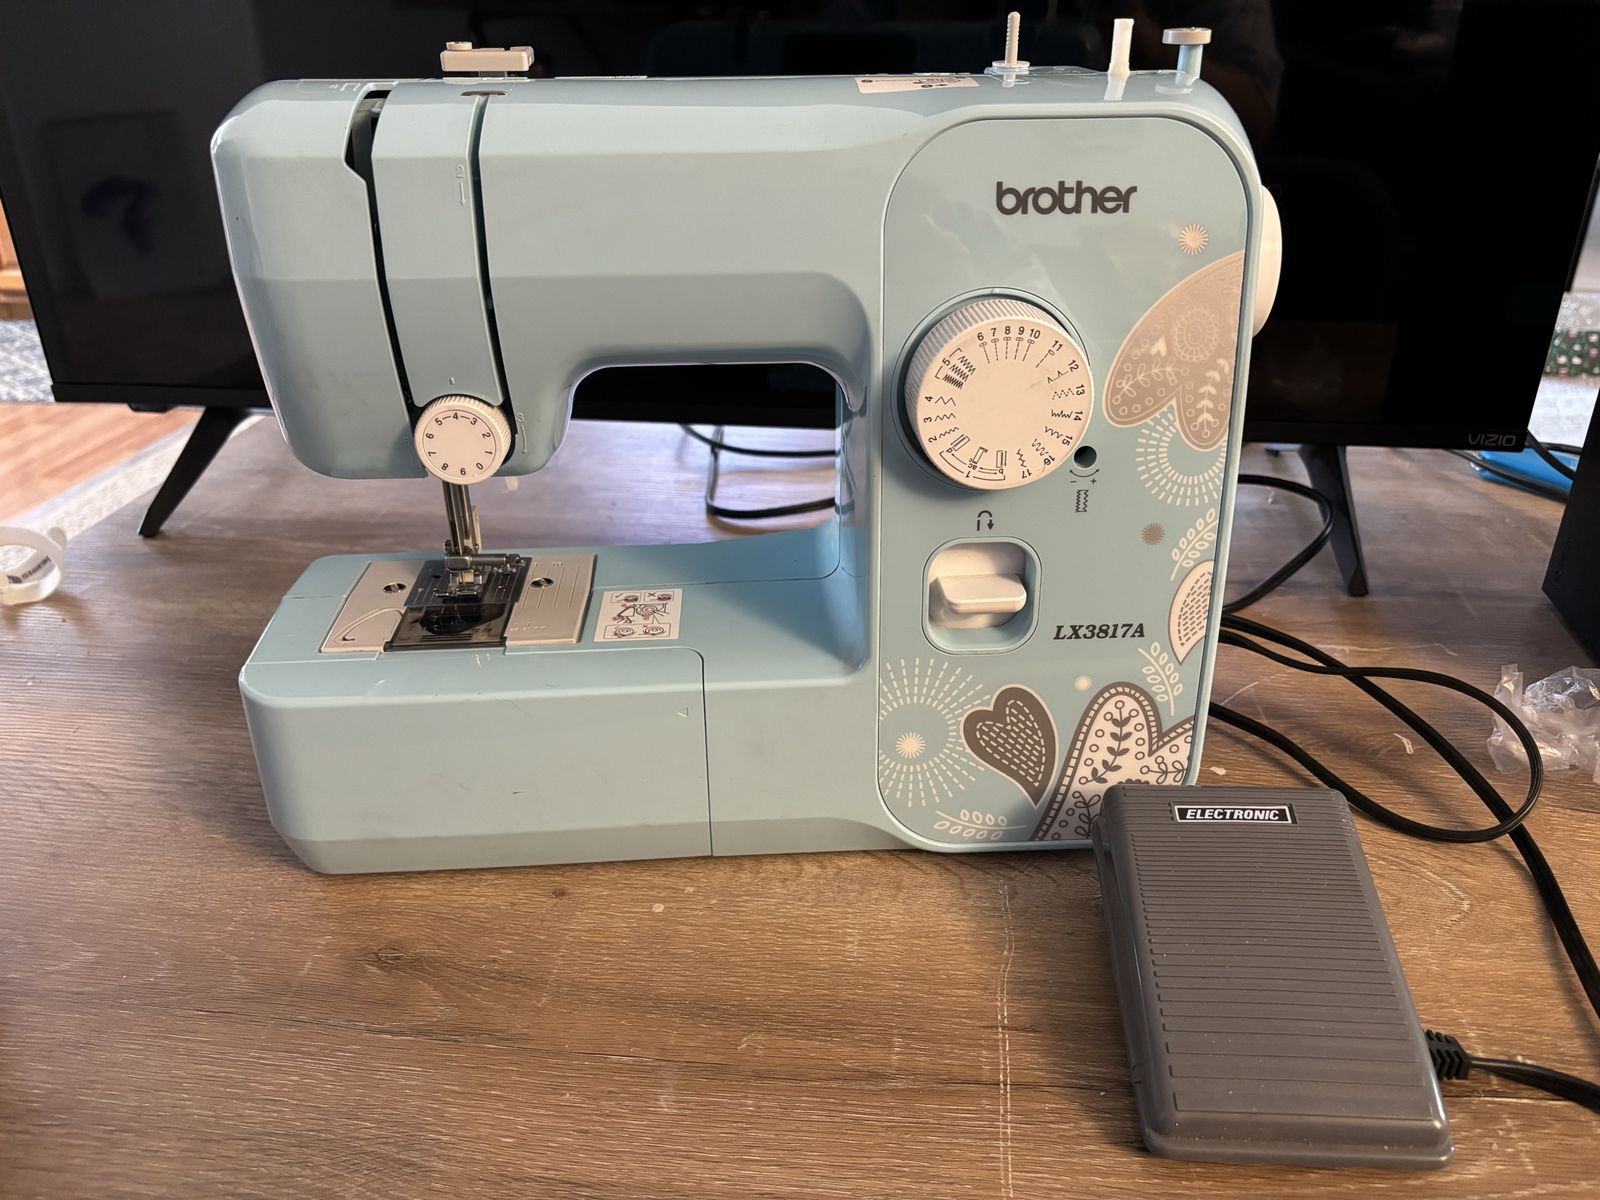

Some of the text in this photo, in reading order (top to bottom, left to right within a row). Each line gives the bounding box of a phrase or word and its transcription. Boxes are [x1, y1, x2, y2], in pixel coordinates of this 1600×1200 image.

[996, 180, 1138, 216] brother
[990, 328, 997, 336] 7
[1004, 326, 1011, 335] 8
[1018, 326, 1025, 335] 9
[1029, 328, 1041, 339] 10
[977, 332, 985, 341] 6
[1051, 340, 1063, 352] 11
[941, 357, 951, 367] 5
[1067, 359, 1079, 373] 12
[1075, 384, 1086, 396] 13
[924, 395, 934, 403] 4
[452, 412, 459, 420] 4
[923, 416, 933, 424] 3
[1073, 410, 1084, 422] 14
[434, 417, 443, 426] 5
[470, 417, 478, 426] 3
[425, 432, 435, 440] 6
[482, 432, 491, 440] 2
[927, 435, 938, 443] 2
[1061, 435, 1073, 446] 15
[1468, 433, 1517, 447] VIZIO
[1043, 455, 1055, 466] 16
[441, 462, 449, 471] 8
[476, 462, 484, 470] 0
[965, 470, 971, 478] 1
[1021, 468, 1032, 479] 17
[1053, 623, 1145, 640] LX3817A
[1185, 809, 1280, 820] ELECTRONIC
